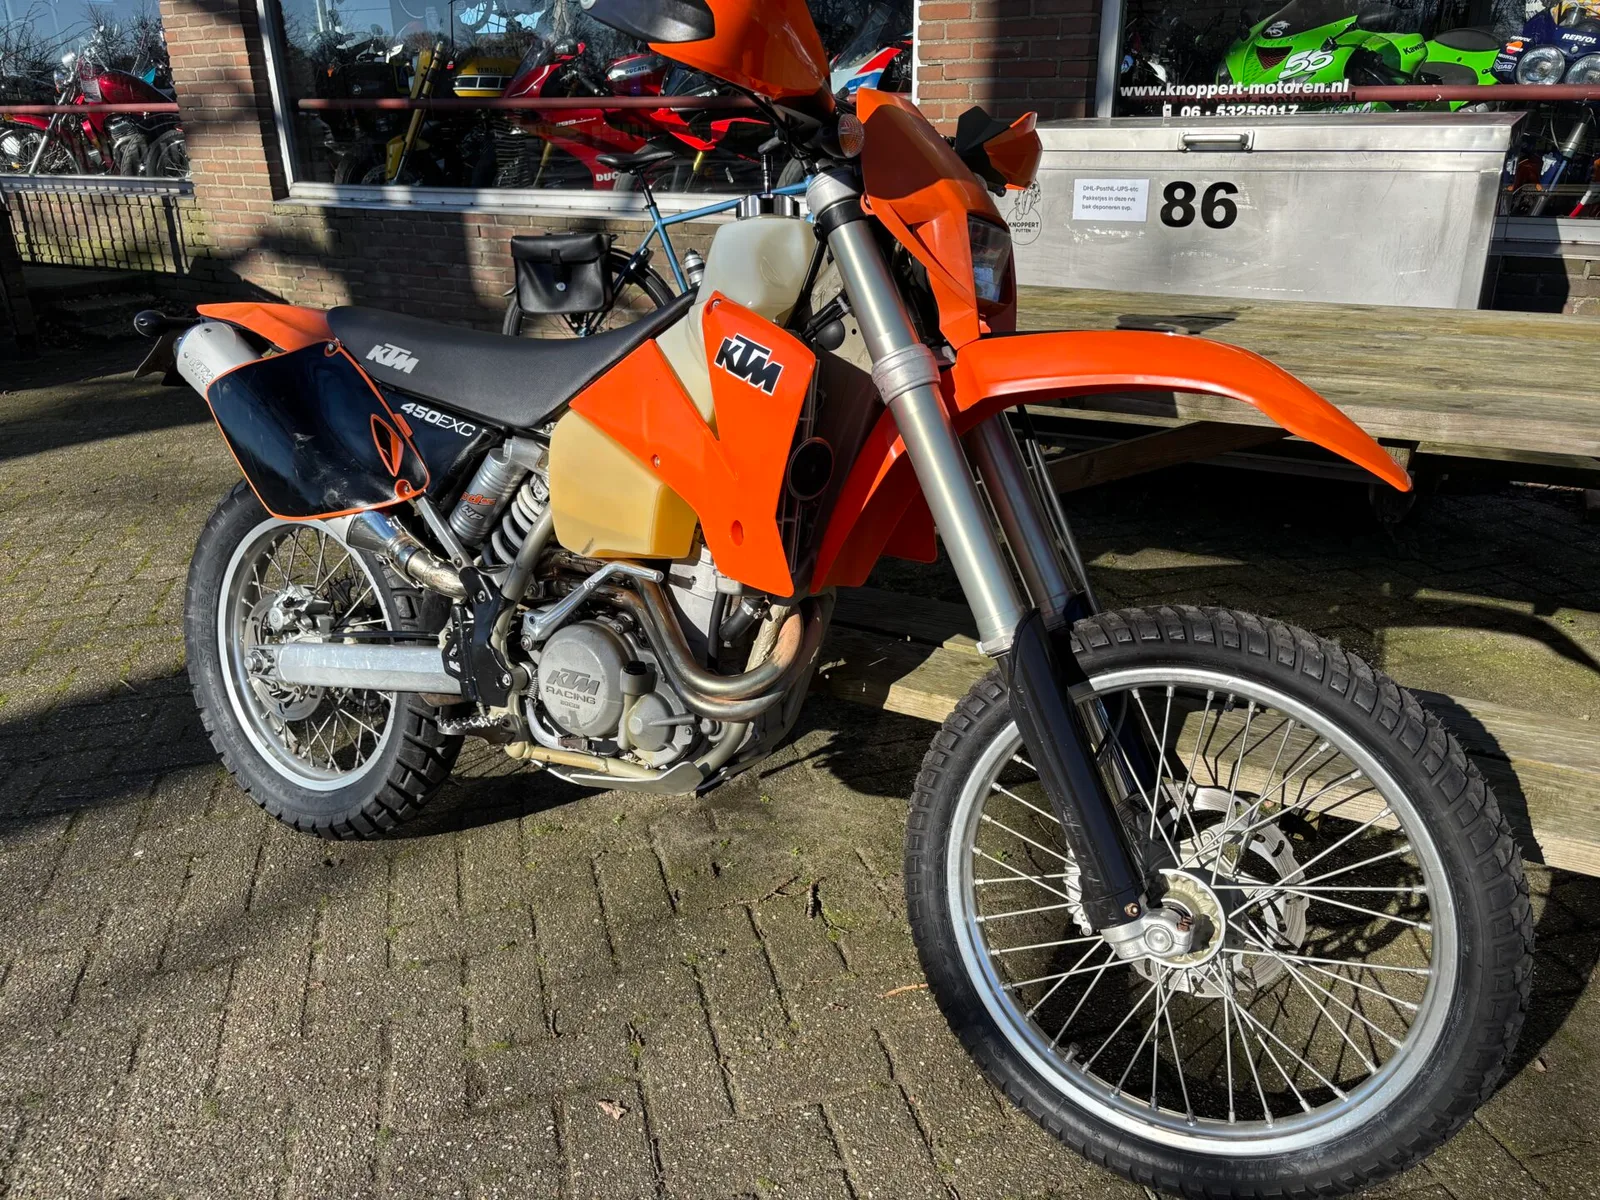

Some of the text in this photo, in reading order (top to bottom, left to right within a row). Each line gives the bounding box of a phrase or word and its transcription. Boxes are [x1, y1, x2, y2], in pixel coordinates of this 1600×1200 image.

[1562, 33, 1597, 44] REPSOL
[1498, 53, 1517, 61] HONDA
[624, 65, 648, 75] DUCATI
[1120, 79, 1349, 98] www.knoppert-motoren.nl
[1180, 105, 1200, 117] 06
[1215, 104, 1299, 116] 53256017
[1160, 181, 1239, 229] 86
[366, 343, 420, 374] KTM
[714, 332, 784, 396] KTM
[400, 402, 476, 437] 450EXC
[461, 504, 485, 520] WP
[199, 580, 216, 673] SAHARA
[546, 667, 600, 696] KTM
[545, 685, 596, 705] RACING
